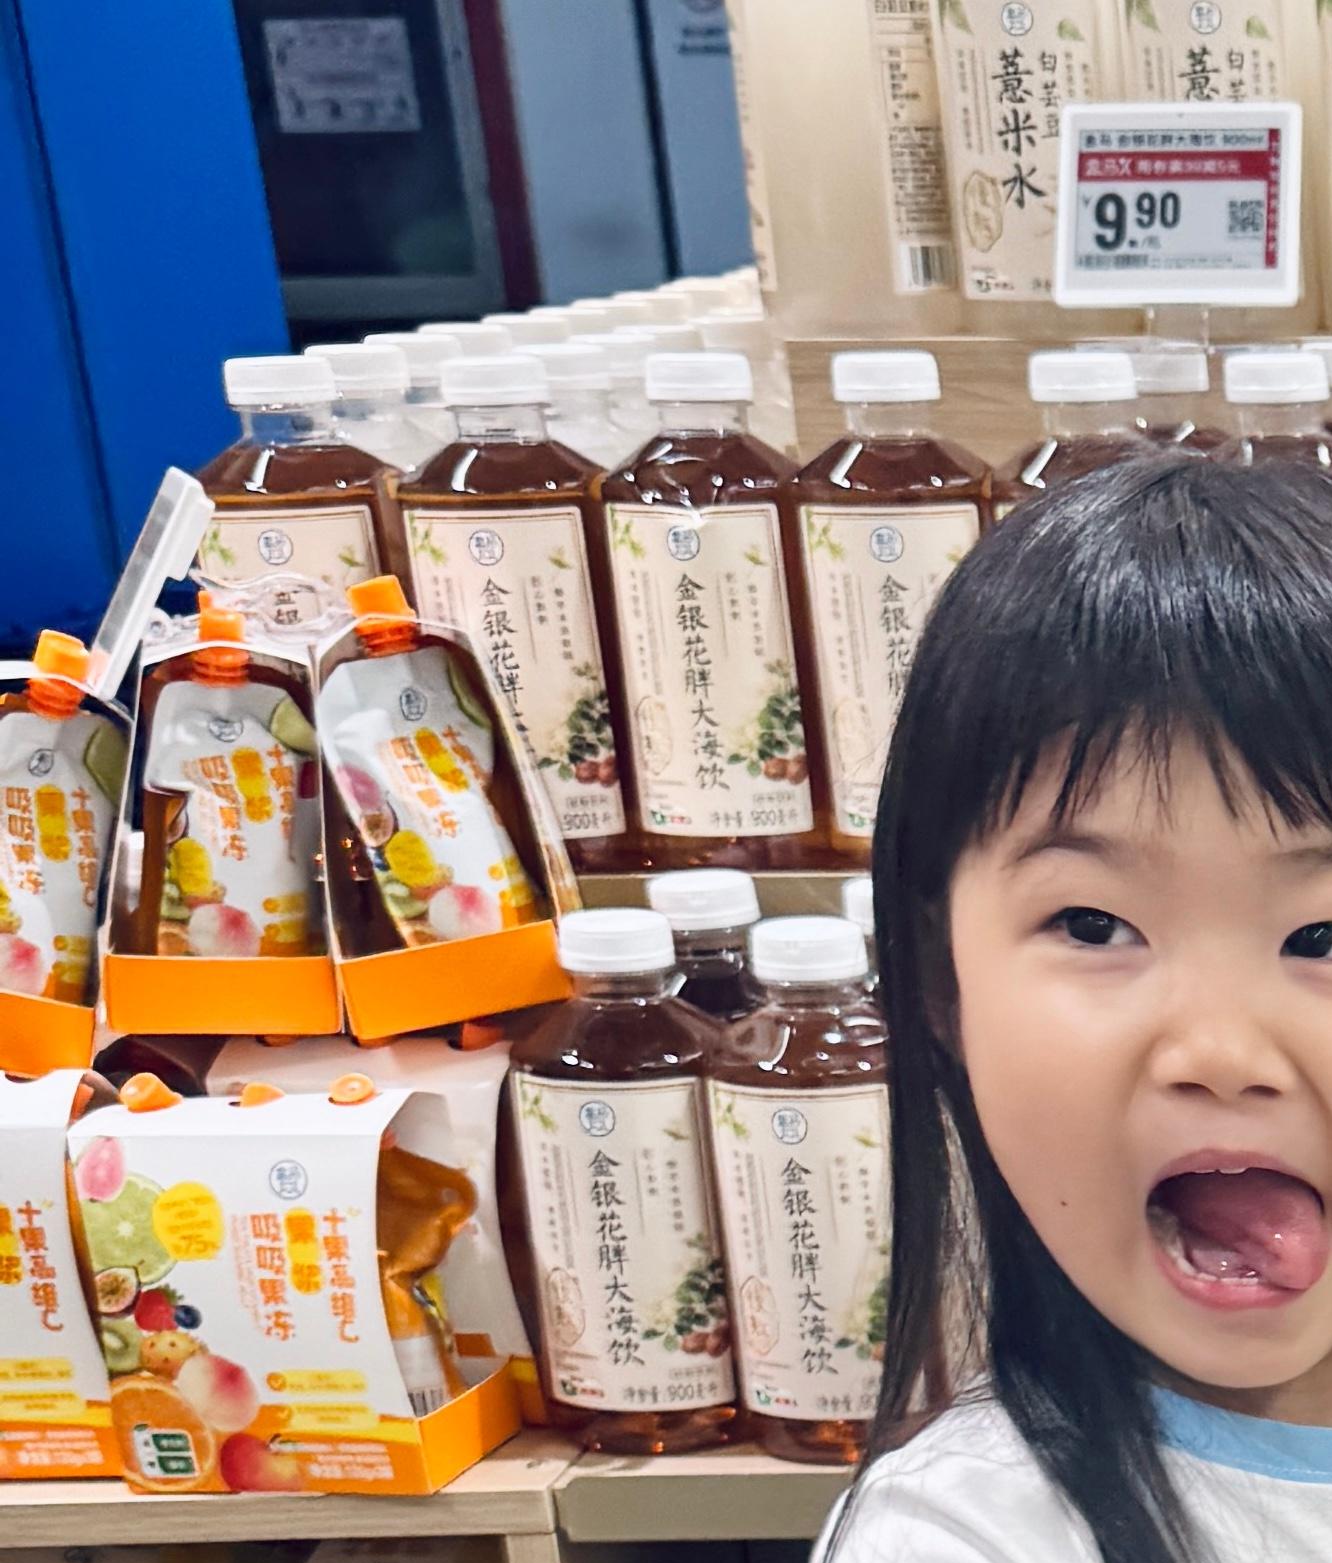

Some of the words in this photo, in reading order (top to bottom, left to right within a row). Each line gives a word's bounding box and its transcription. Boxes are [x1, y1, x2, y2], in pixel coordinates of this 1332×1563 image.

[992, 48, 1046, 208] 薏米水
[675, 572, 731, 791] 金银花胖大海饮
[587, 1150, 646, 1366] 金银花胖大海饮
[780, 1159, 838, 1375] 金银花胖大海饮
